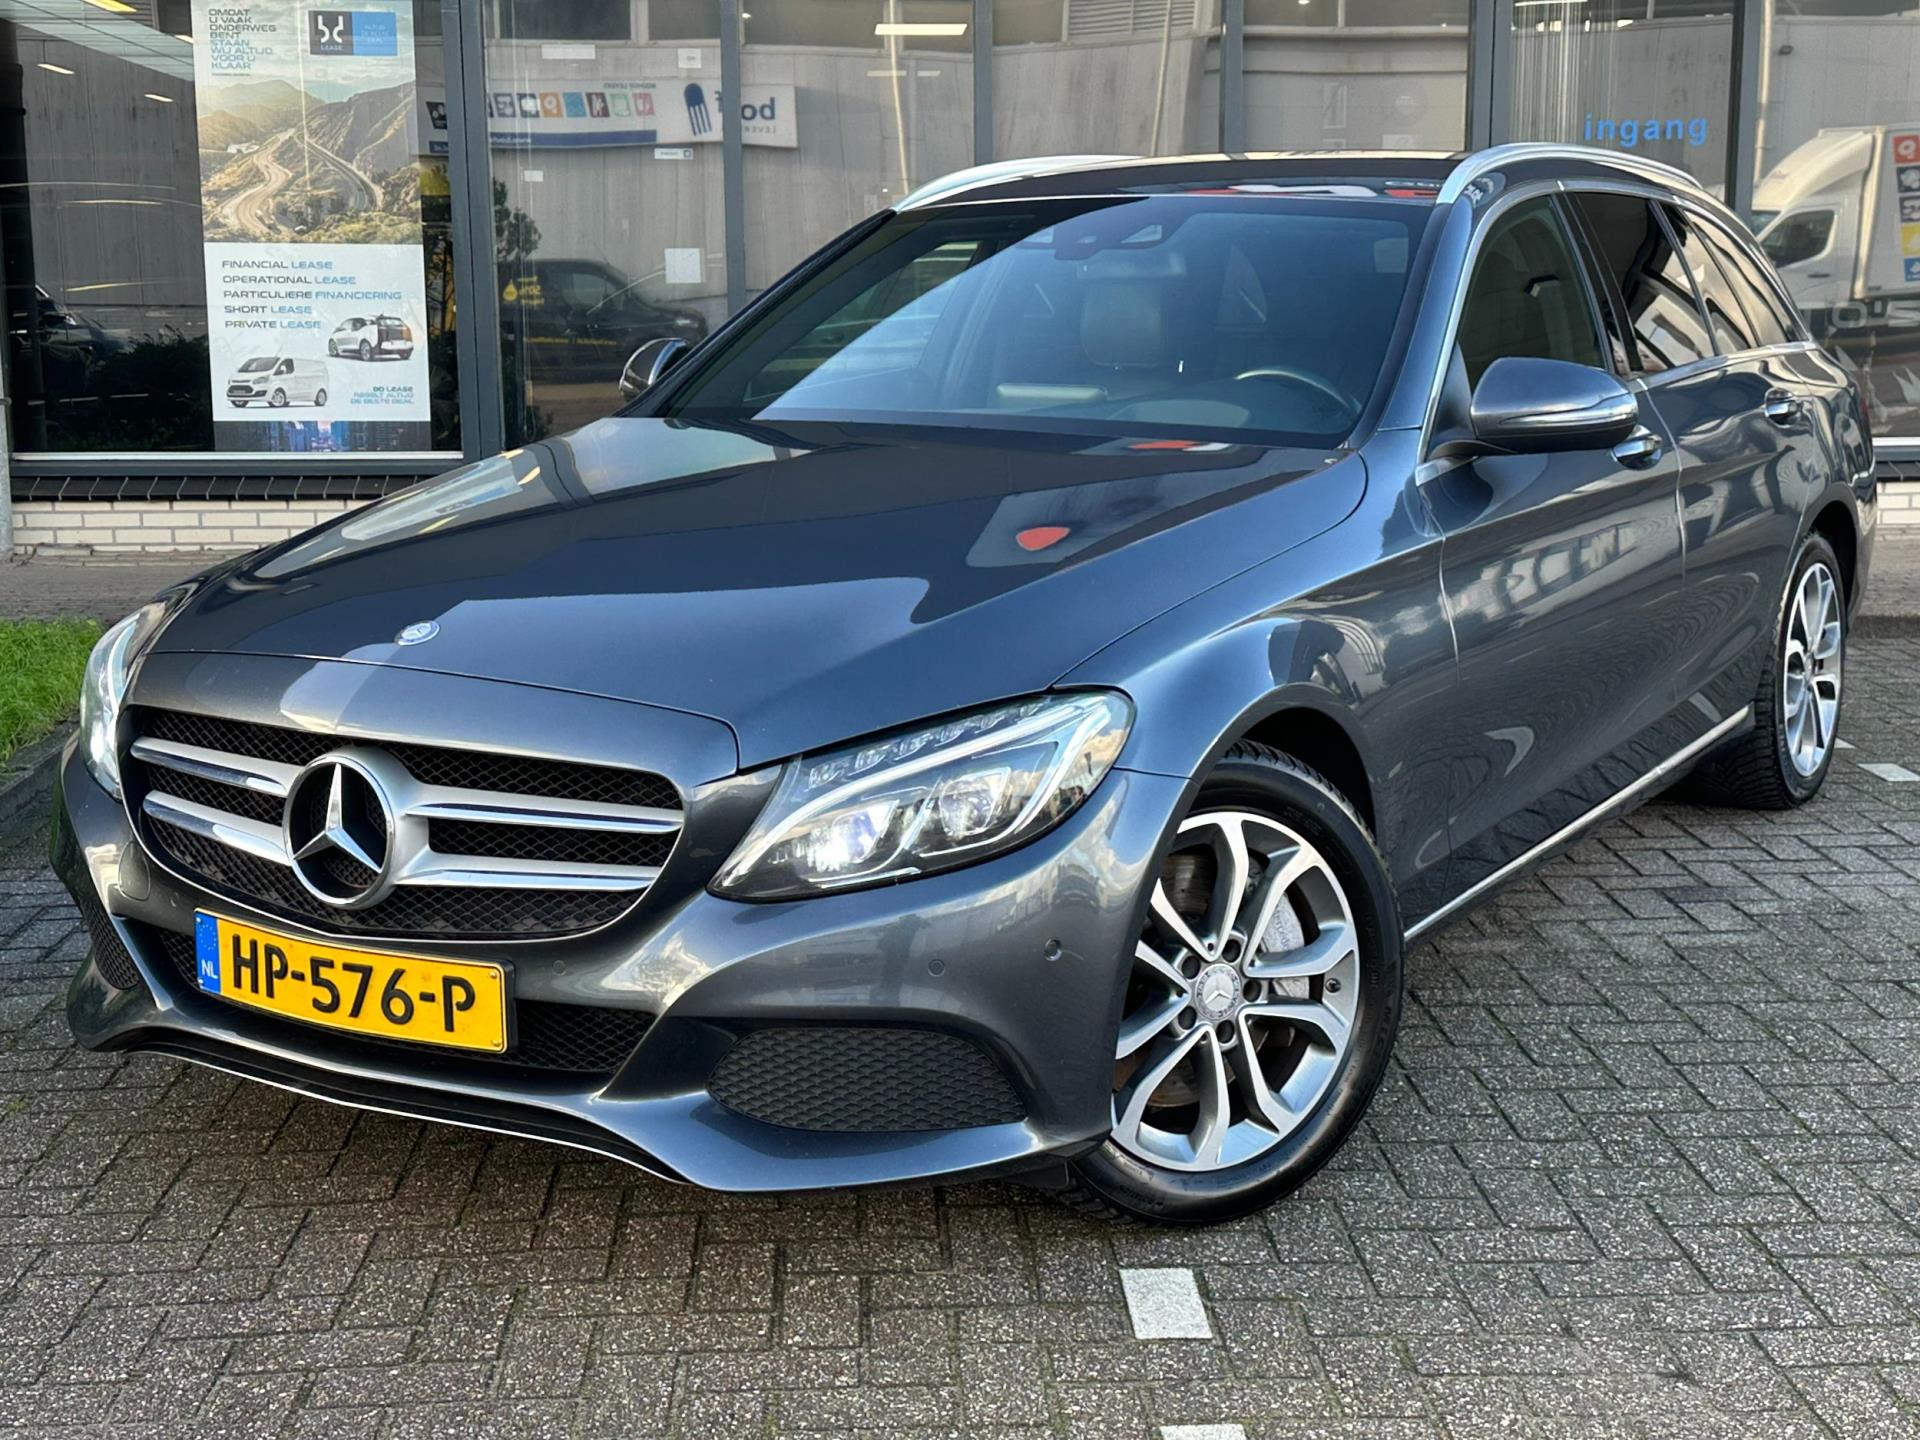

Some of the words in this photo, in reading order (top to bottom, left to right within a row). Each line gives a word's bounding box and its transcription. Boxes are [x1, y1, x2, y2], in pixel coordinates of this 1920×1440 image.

[208, 8, 250, 16] OMDAT
[209, 24, 277, 32] ONDERWEG
[211, 54, 244, 62] VOOR
[247, 54, 256, 62] U
[211, 62, 251, 70] KLAAR
[1584, 113, 1708, 146] ingang
[222, 260, 288, 269] FINANCIAL
[291, 261, 333, 270] LEASE
[222, 275, 312, 284] OPERATIONAL
[314, 276, 356, 285] LEASE
[223, 290, 312, 299] PARTICULIERE
[315, 291, 402, 300] FINANCIERING
[224, 305, 267, 314] SHORT
[270, 306, 312, 314] LEASE
[225, 320, 277, 329] PRIVATE
[280, 321, 321, 329] LEASE
[201, 959, 218, 979] NL
[232, 934, 475, 1033] HP-576-P
